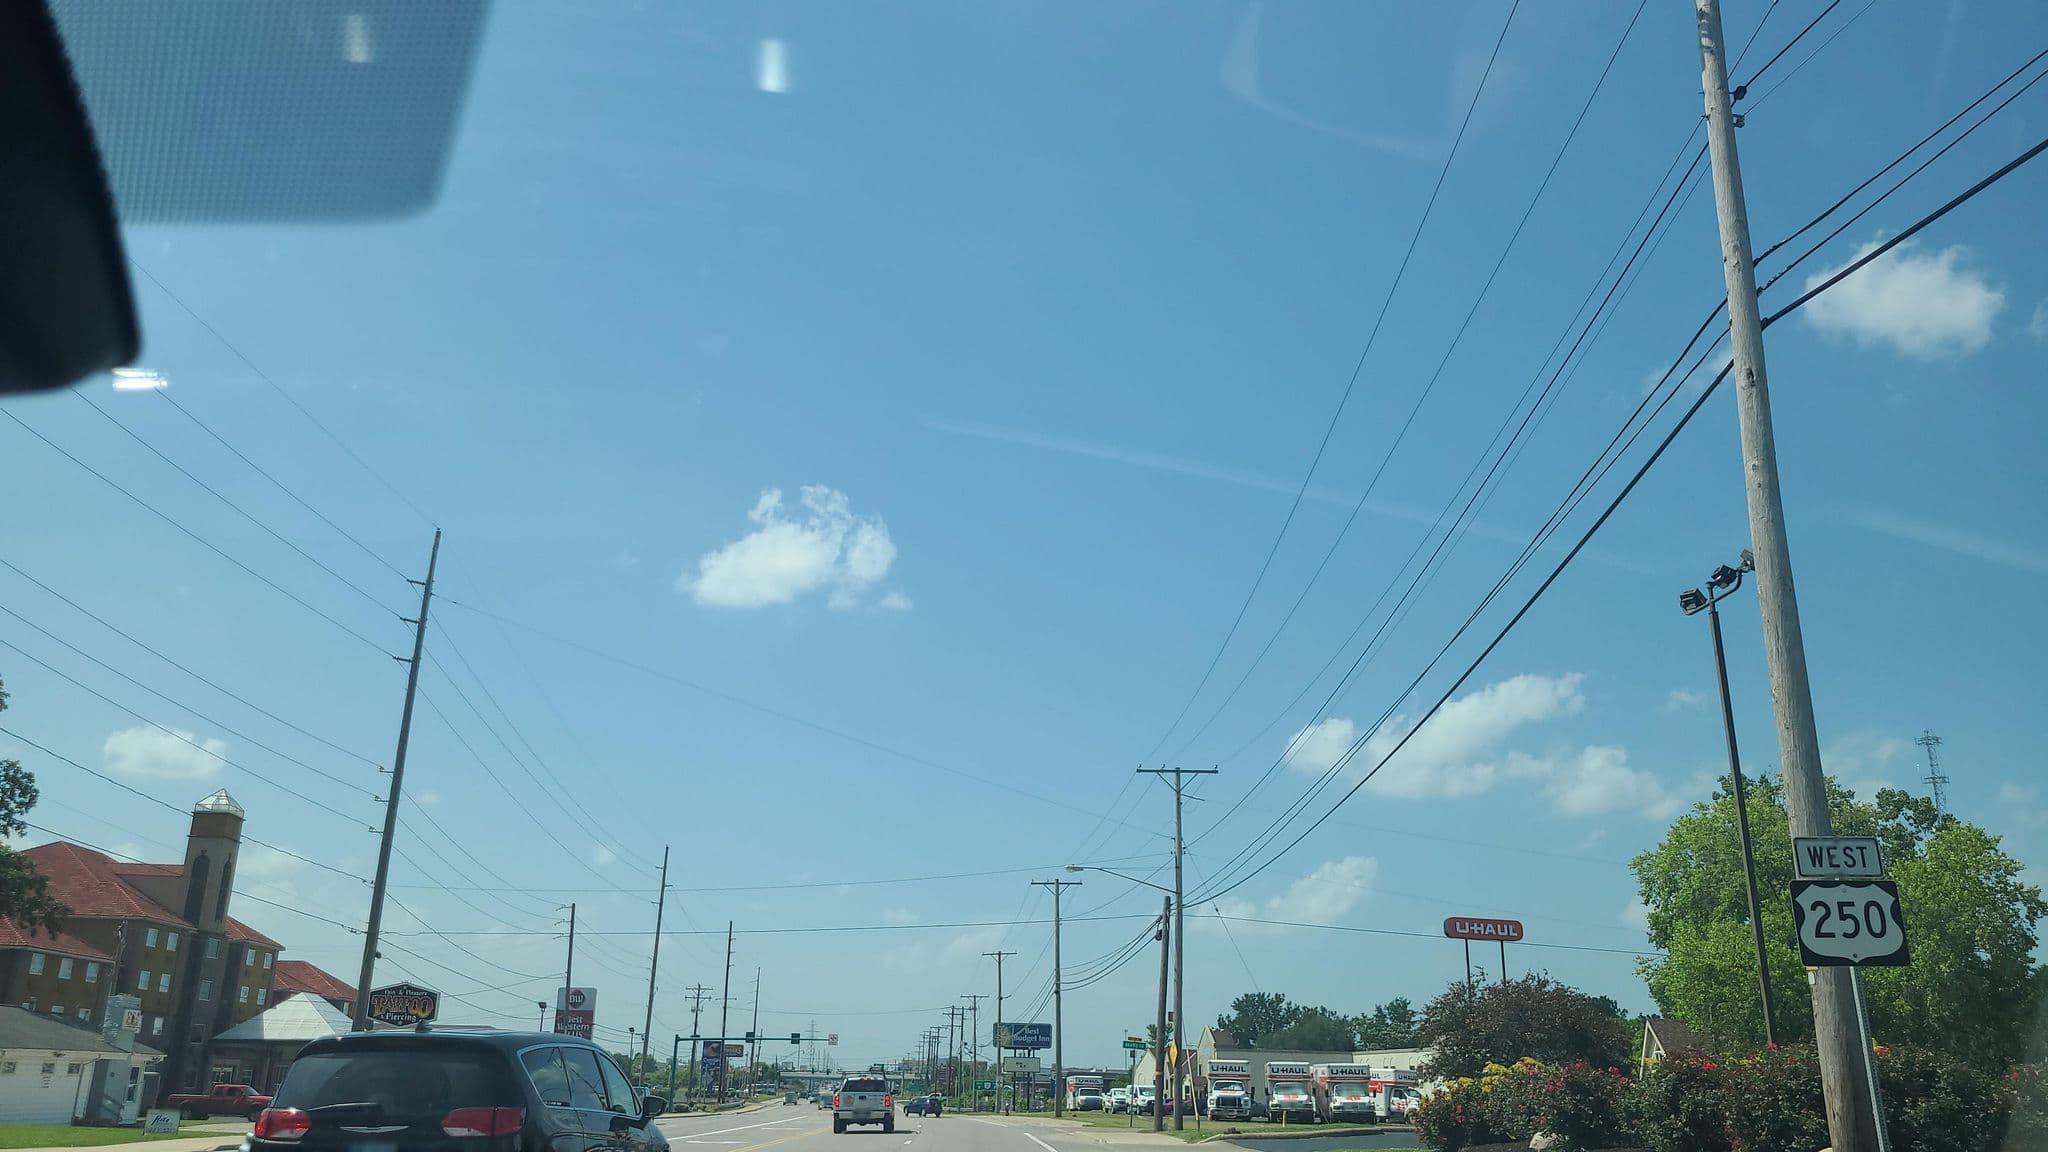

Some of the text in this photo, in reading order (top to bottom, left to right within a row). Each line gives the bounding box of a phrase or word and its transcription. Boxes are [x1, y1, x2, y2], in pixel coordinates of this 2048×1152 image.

[1807, 846, 1867, 868] WEST
[1810, 900, 1887, 939] 250
[1455, 921, 1518, 937] U-HAUL
[386, 1012, 417, 1022] Piercing
[1013, 1034, 1050, 1043] Budget Inn
[1211, 1065, 1247, 1073] U-HAUL
[1330, 1068, 1367, 1076] U-HAUL
